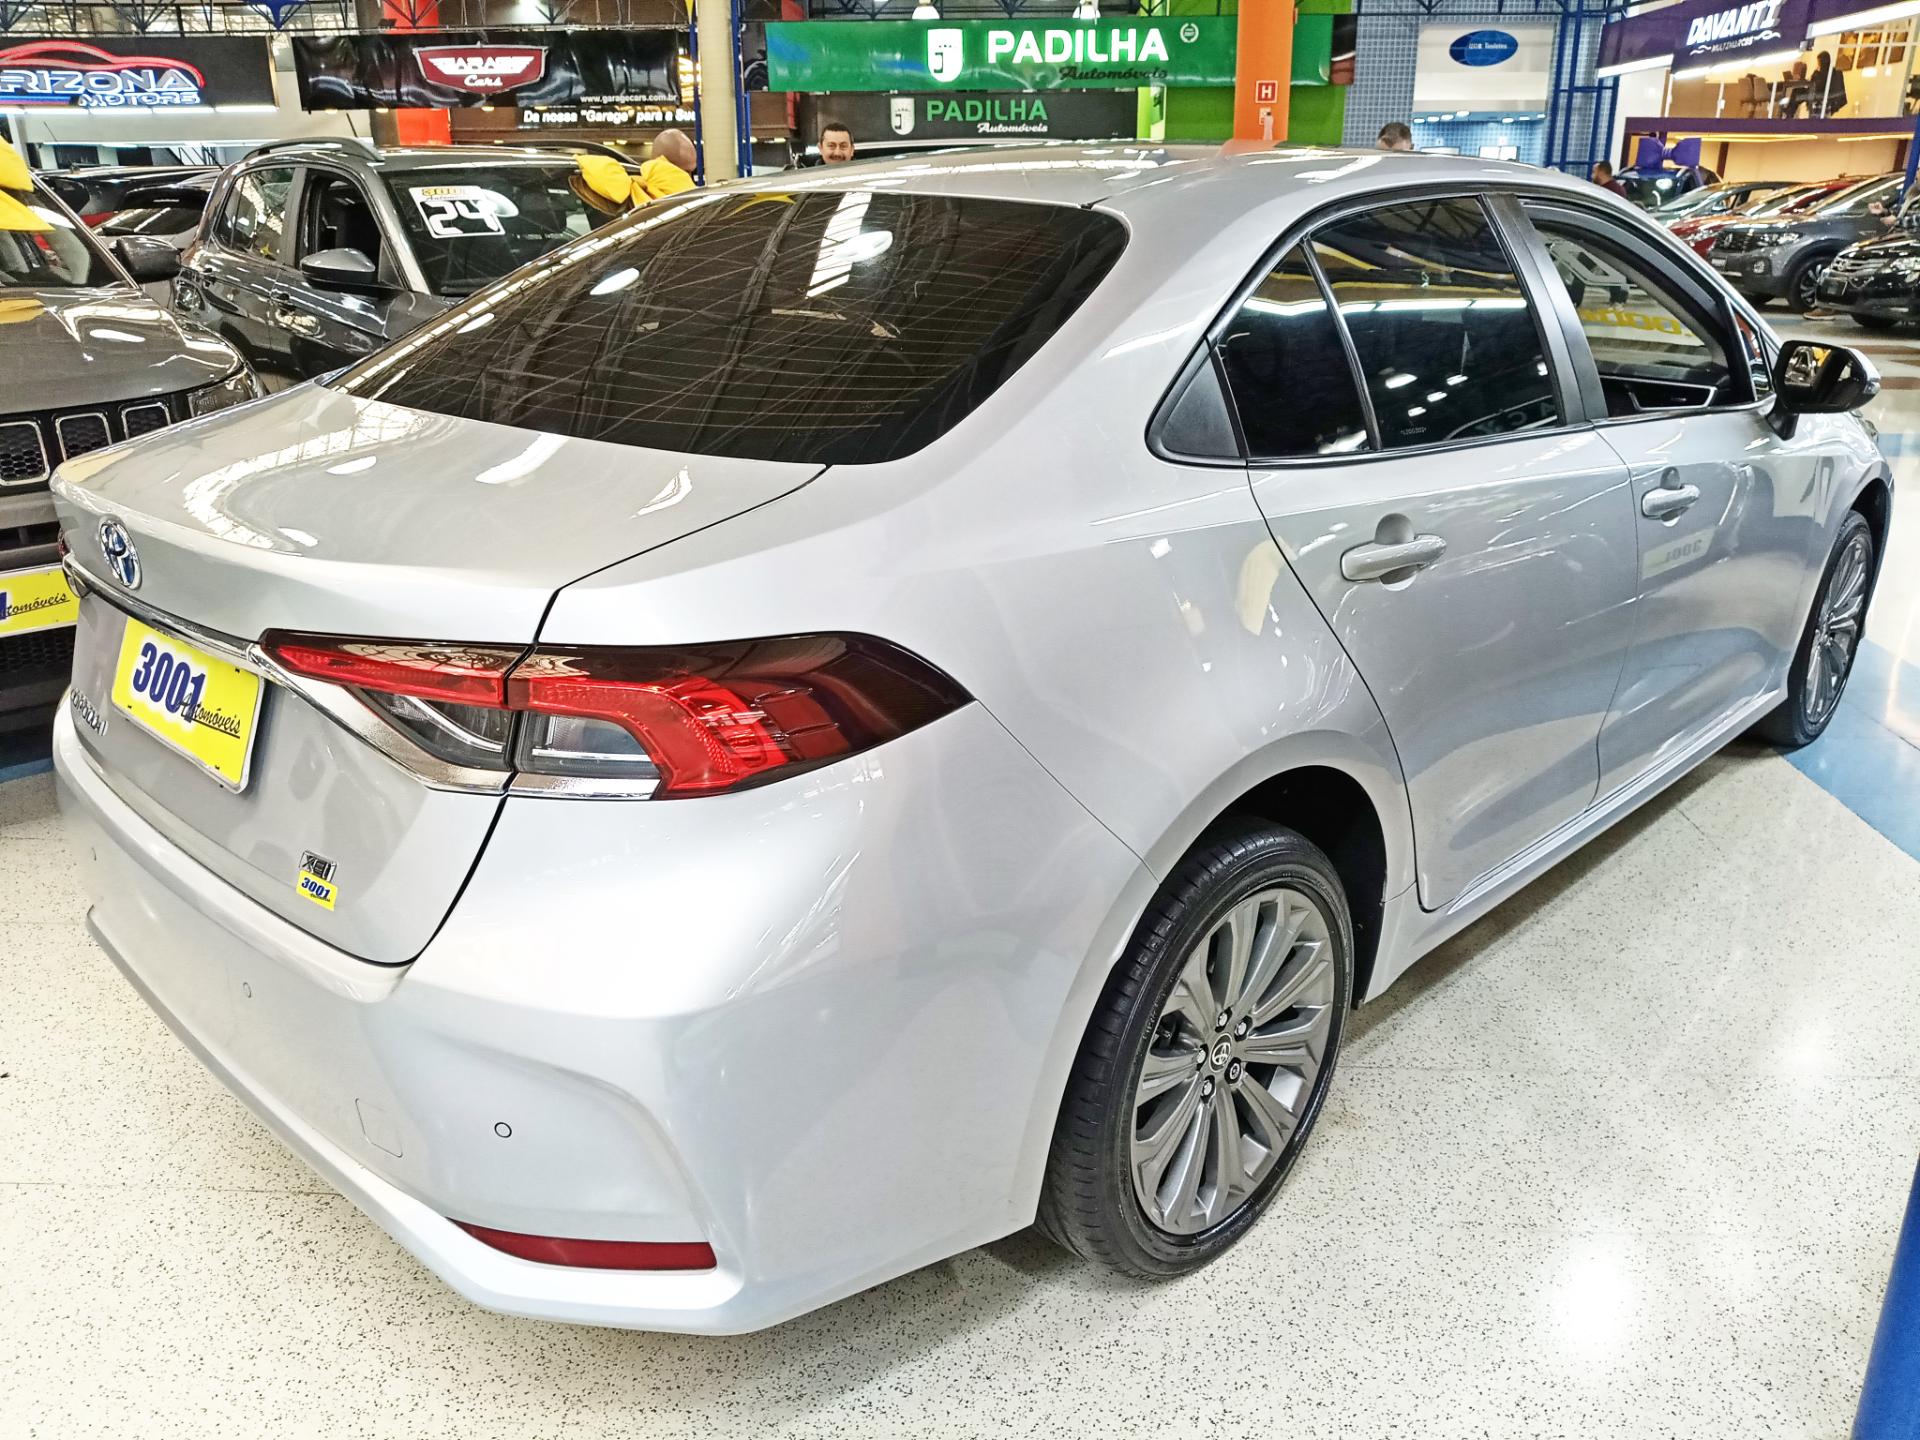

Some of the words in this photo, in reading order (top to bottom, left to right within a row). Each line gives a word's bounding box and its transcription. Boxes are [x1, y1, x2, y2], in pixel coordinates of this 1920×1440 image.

[1686, 0, 1781, 46] DAVANTI
[988, 28, 1169, 64] PADILHA
[0, 69, 199, 95] RIZONA
[464, 75, 503, 87] Cars
[78, 92, 200, 107] MOTORS
[580, 94, 679, 105] www.garagecars.com.br
[926, 99, 1048, 121] PADILHA
[542, 111, 578, 123] nossa
[636, 111, 663, 124] para
[977, 121, 1048, 133] Automóveis
[427, 200, 500, 235] 24
[1, 592, 67, 616] tomóveis
[132, 642, 206, 723] 3001
[301, 876, 331, 900] 3001
